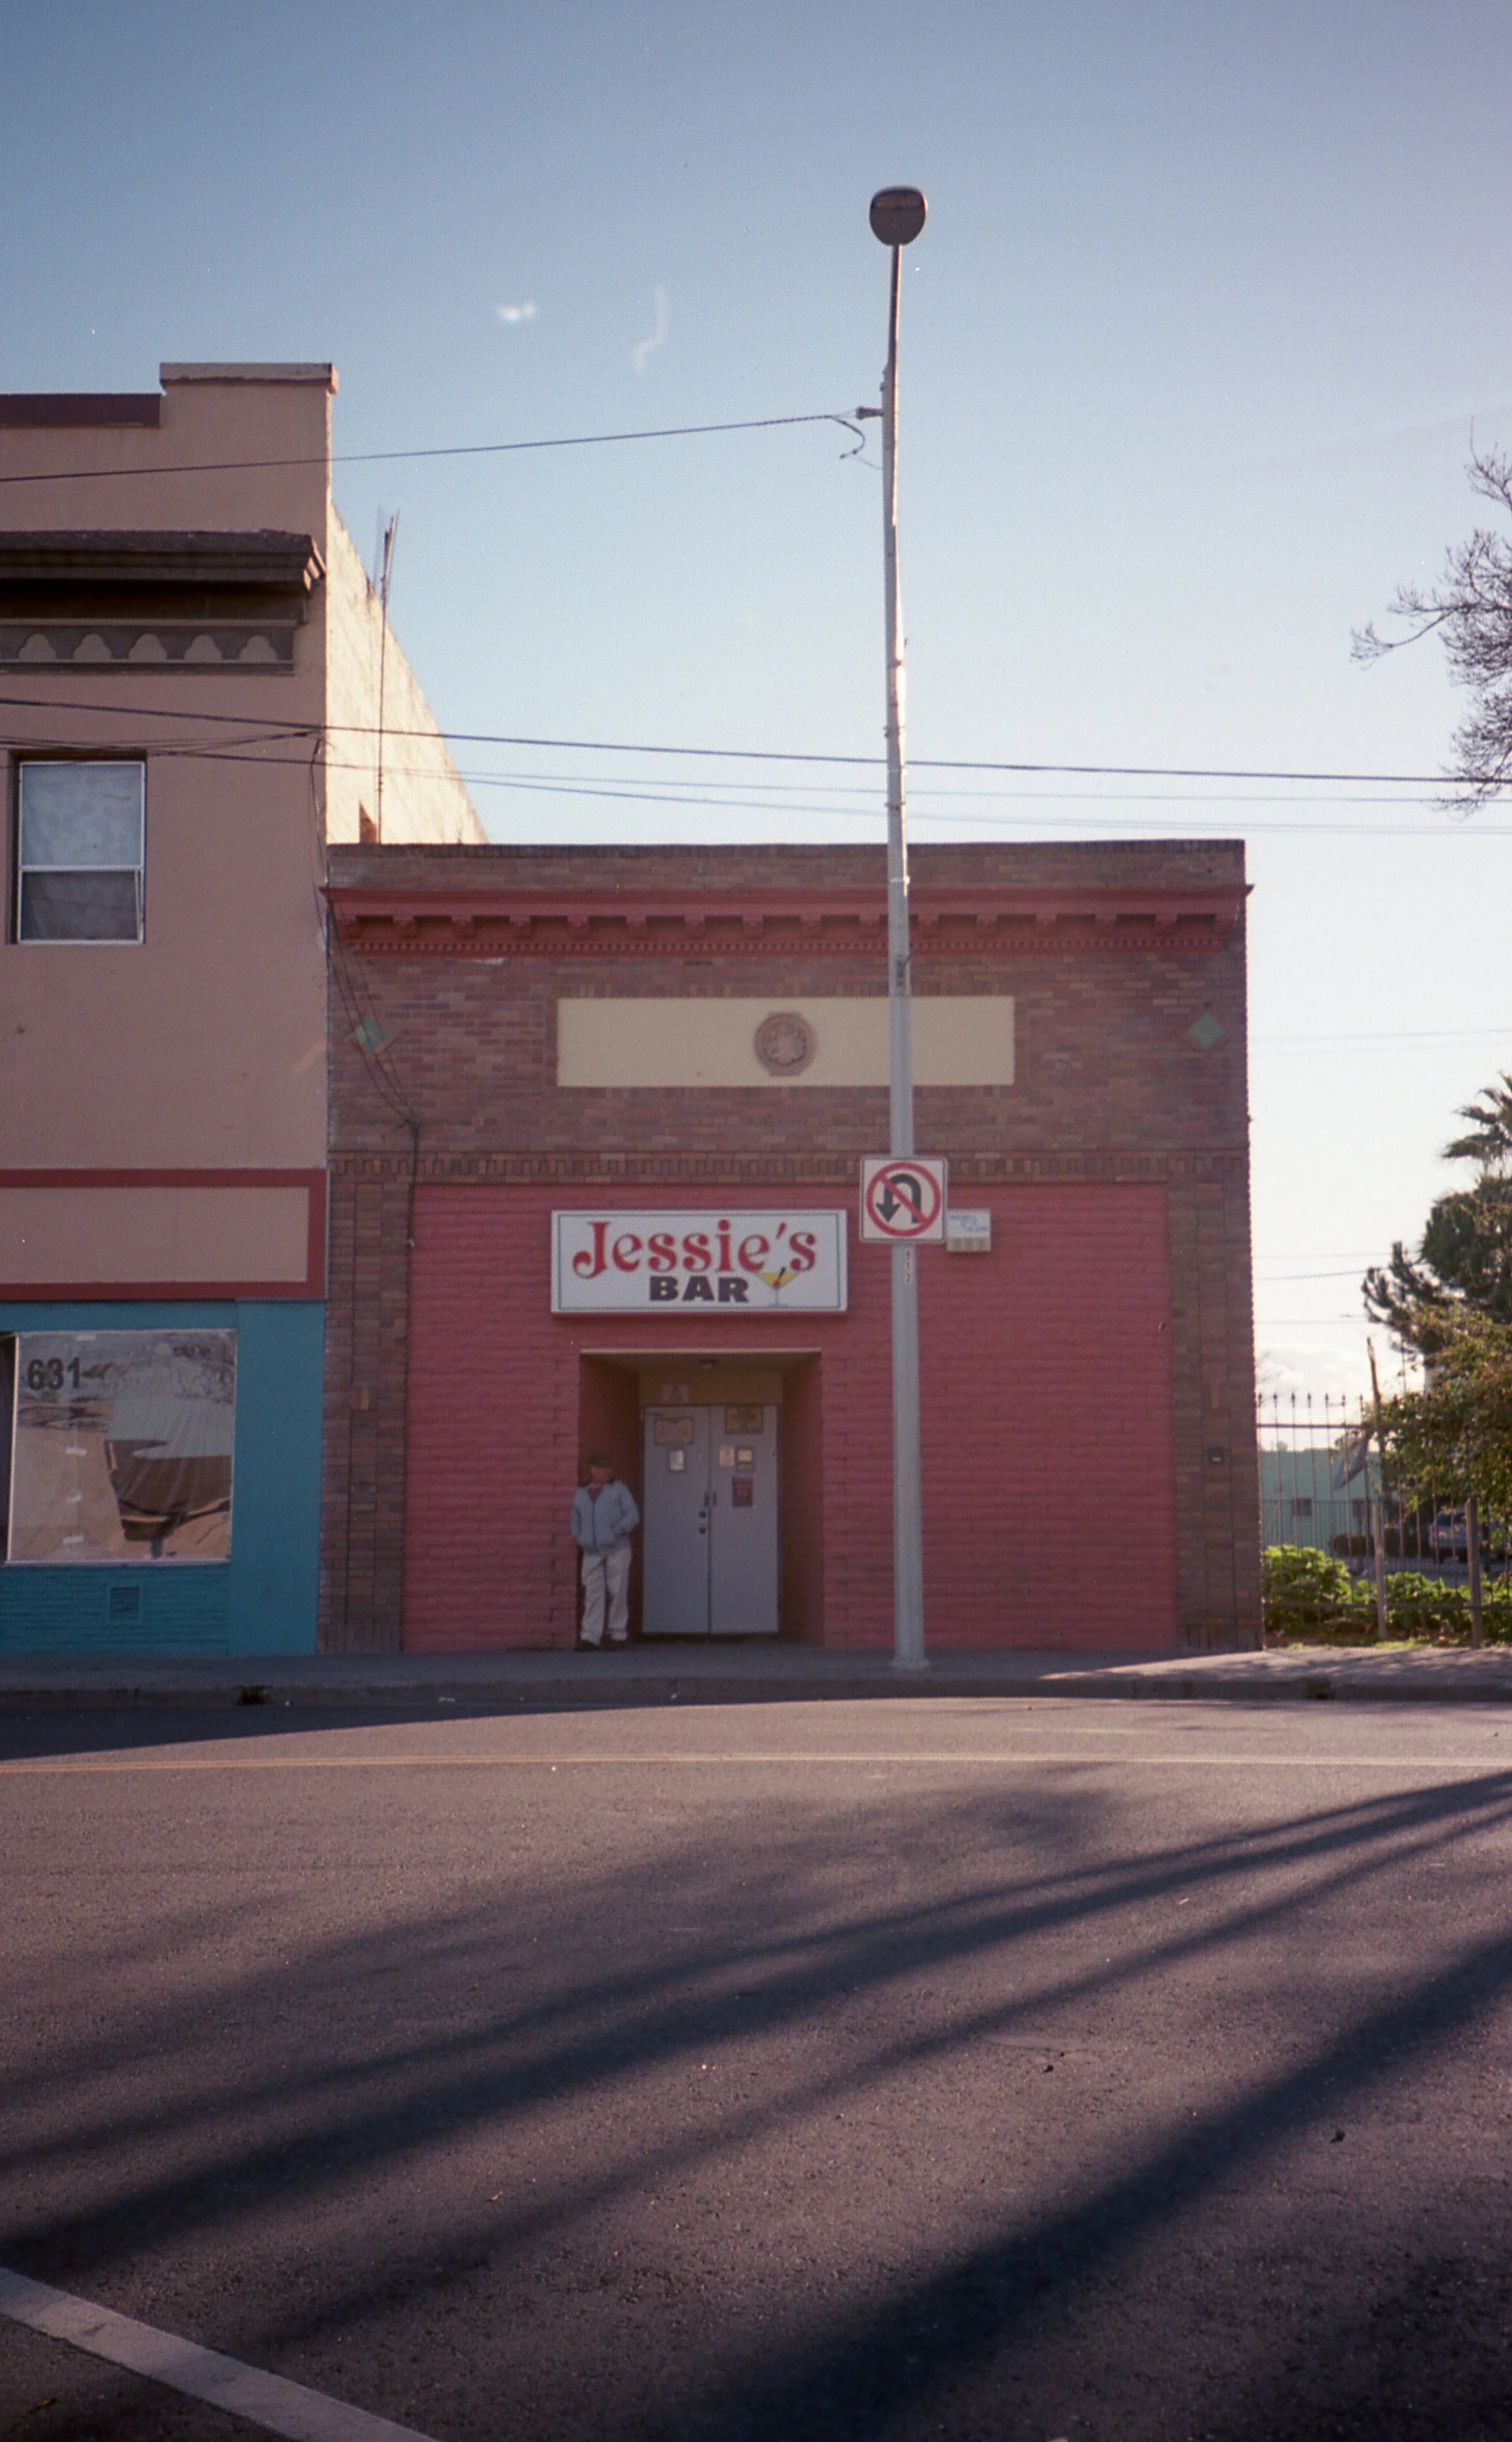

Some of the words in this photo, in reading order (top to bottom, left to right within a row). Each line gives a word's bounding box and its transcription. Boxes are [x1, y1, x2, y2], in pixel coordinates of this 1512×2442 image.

[572, 1219, 816, 1279] Jessie's
[649, 1275, 749, 1303] BAR
[28, 1356, 80, 1391] 631
